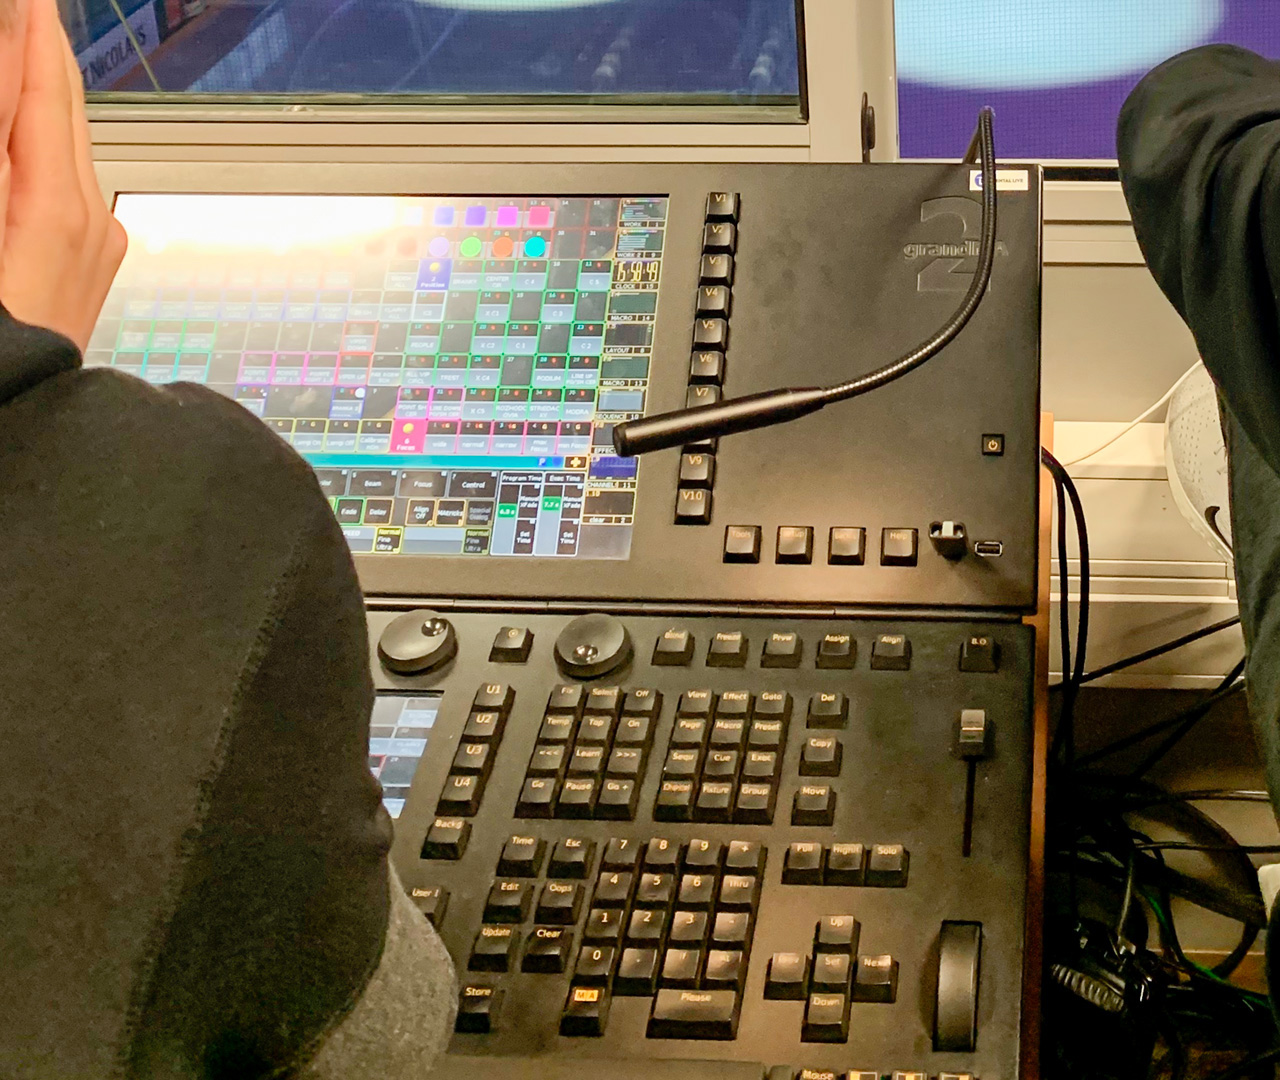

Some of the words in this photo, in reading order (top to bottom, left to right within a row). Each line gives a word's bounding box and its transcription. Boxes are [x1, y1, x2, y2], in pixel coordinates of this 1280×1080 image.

[715, 193, 727, 203] V1
[712, 225, 724, 234] V2
[709, 256, 721, 265] V3
[705, 288, 718, 297] V4
[702, 320, 715, 329] V5
[699, 354, 713, 363] V6
[696, 387, 709, 396] V7
[688, 455, 702, 465] V9
[502, 475, 527, 483] Program
[461, 481, 485, 489] Control
[683, 490, 702, 500] V10
[369, 509, 387, 517] Delay
[413, 506, 430, 514] Align
[890, 532, 908, 540] Help
[824, 634, 849, 644] Assign
[881, 635, 902, 644] Align
[486, 685, 500, 694] U1
[592, 688, 619, 696] Select
[821, 694, 836, 702] Del
[476, 714, 492, 723] U2
[547, 717, 570, 726] Temp
[589, 719, 604, 727] Tap
[627, 720, 640, 728] On
[755, 723, 780, 731] Preset
[810, 740, 832, 749] Copy
[466, 745, 482, 754] U3
[576, 749, 600, 757] Learn
[454, 777, 471, 787] U4
[531, 780, 544, 788] Go
[566, 782, 592, 790] Pause
[741, 787, 768, 796] Group
[802, 787, 826, 795] Move
[512, 836, 534, 845] Time
[566, 839, 582, 847] Esc
[620, 839, 628, 850] 7
[659, 840, 668, 850] 8
[700, 840, 709, 851] 9
[877, 846, 897, 855] Solo
[610, 876, 618, 885] 4
[653, 876, 661, 886] 5
[693, 877, 701, 887] 6
[729, 880, 749, 888] Thru
[500, 883, 520, 891] Edit
[550, 884, 573, 893] Oops
[412, 889, 432, 897] User
[601, 912, 608, 923] 1
[643, 912, 651, 922] 2
[686, 914, 694, 924] 3
[830, 918, 843, 927] Up
[482, 928, 511, 937] Update
[536, 929, 562, 938] Clear
[592, 950, 601, 960] 0
[465, 987, 491, 997] Store
[681, 992, 712, 1002] Please
[813, 996, 840, 1005] Down
